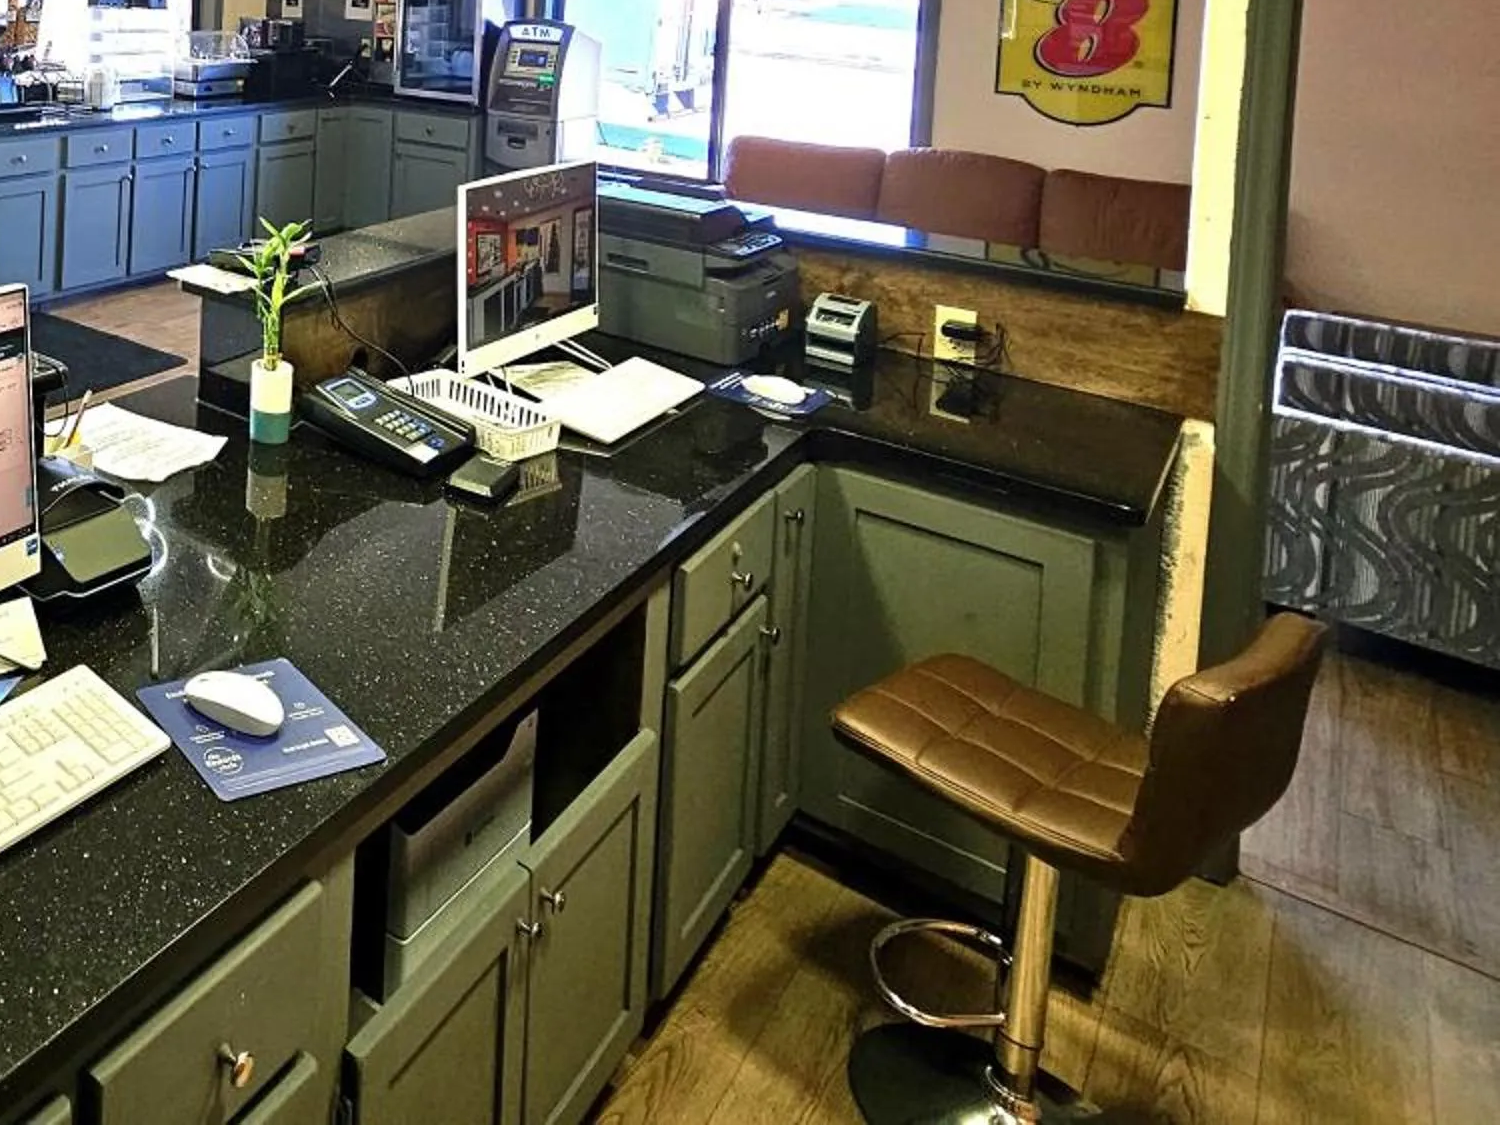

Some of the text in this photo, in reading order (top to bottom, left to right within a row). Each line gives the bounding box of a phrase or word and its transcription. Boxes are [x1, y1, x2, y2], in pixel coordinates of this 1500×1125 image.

[522, 26, 551, 38] ATM
[1021, 79, 1141, 99] BY WYNDHAM
